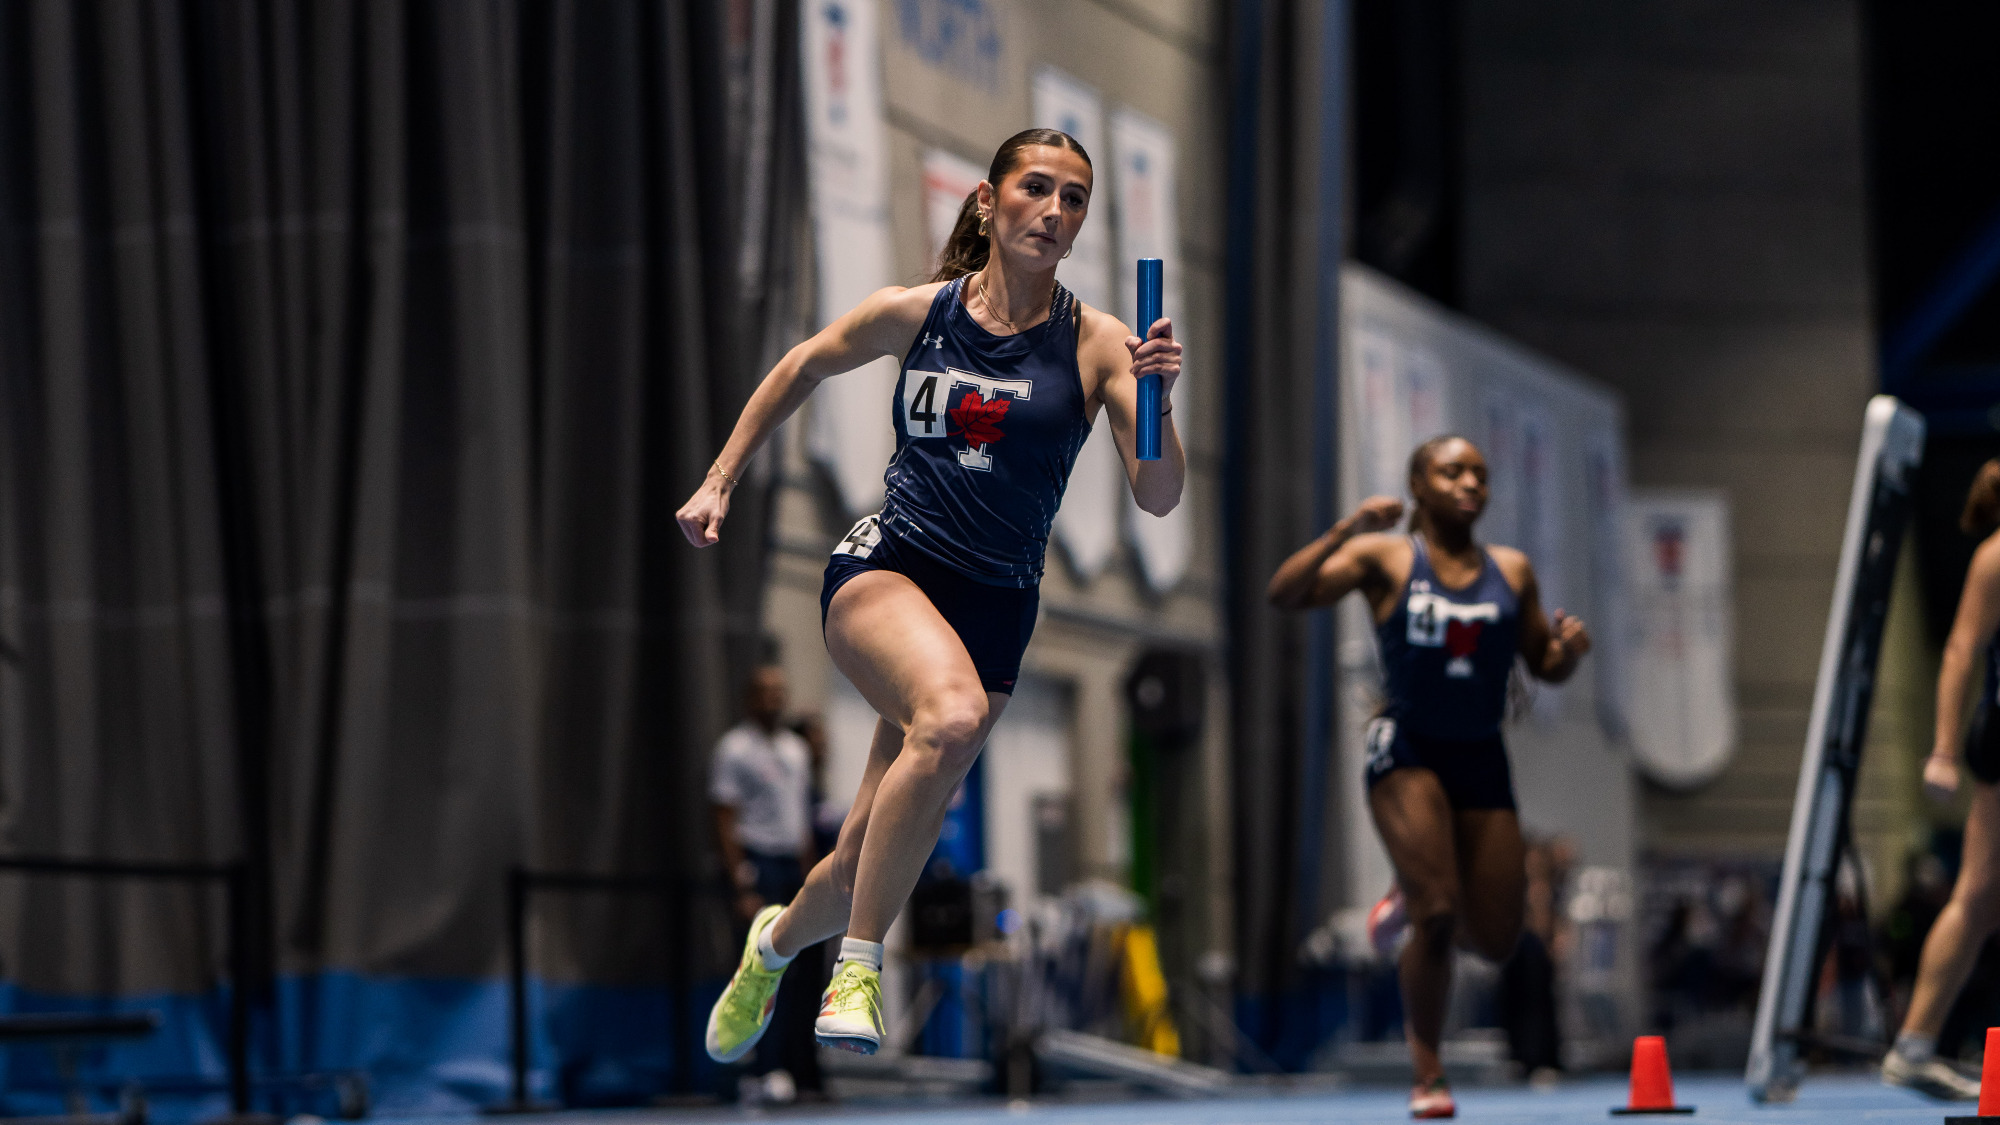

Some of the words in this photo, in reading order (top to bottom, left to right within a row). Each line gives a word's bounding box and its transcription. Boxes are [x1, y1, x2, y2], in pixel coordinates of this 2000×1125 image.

[910, 376, 938, 433] 4
[946, 367, 1032, 472] T
[844, 518, 878, 555] 4
[1417, 602, 1436, 638] 4
